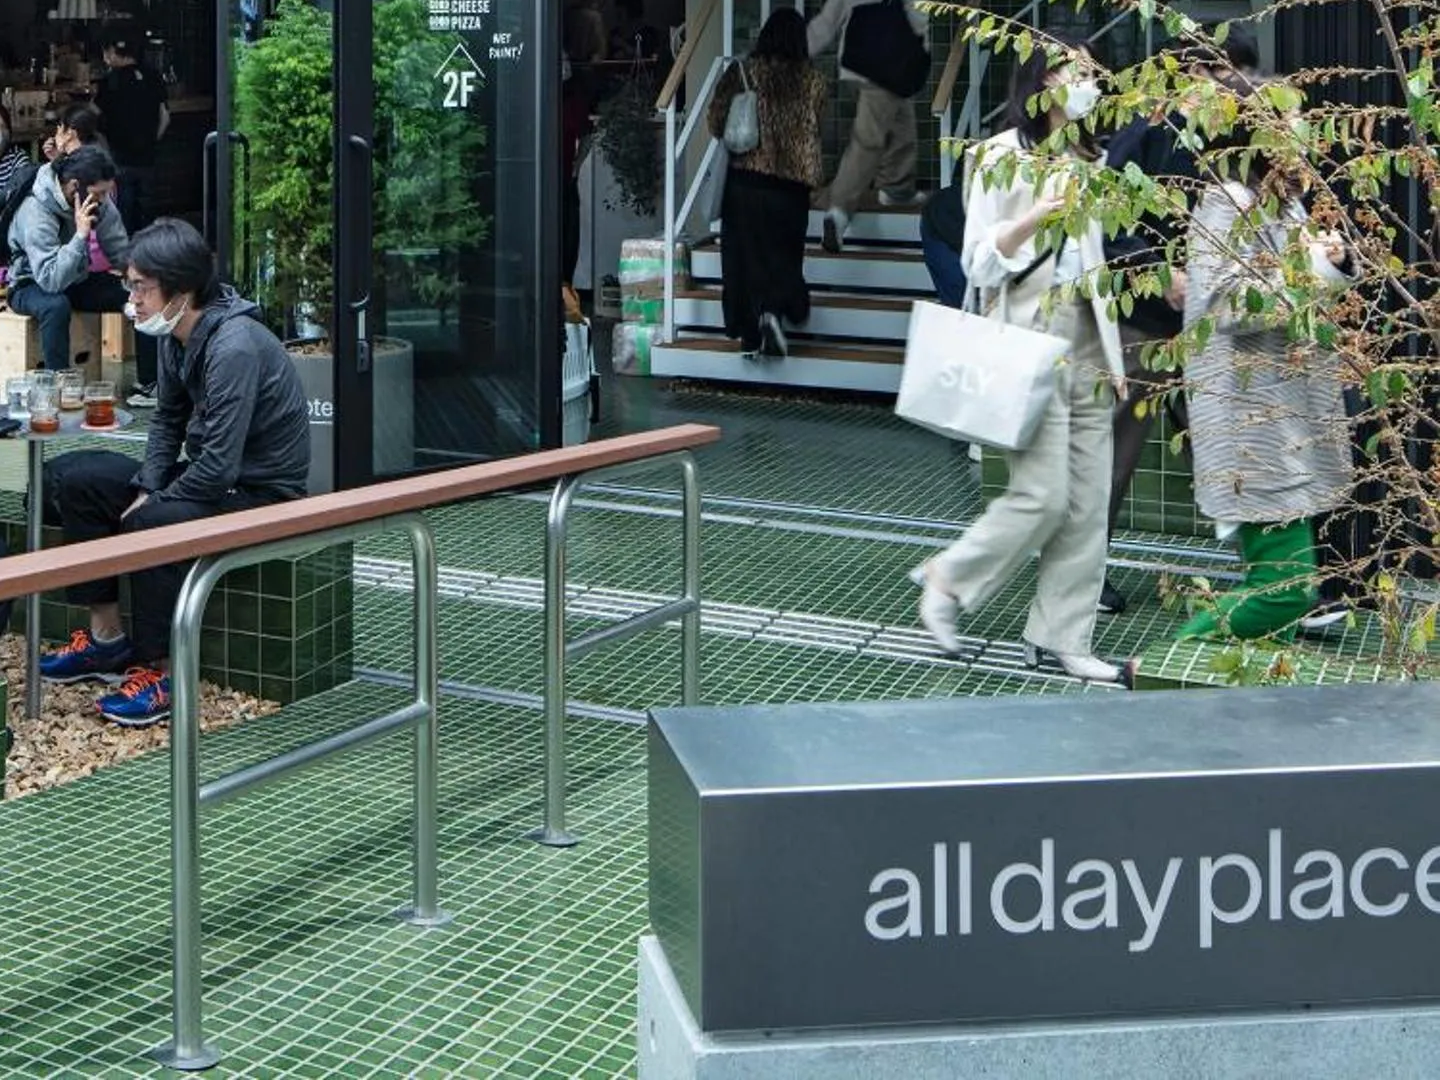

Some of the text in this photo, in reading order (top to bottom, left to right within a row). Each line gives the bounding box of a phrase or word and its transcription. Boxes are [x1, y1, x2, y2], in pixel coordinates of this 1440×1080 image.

[451, 0, 490, 13] CHEESE
[451, 15, 481, 30] PIZZA
[443, 71, 477, 108] 2F
[939, 358, 997, 396] SLY
[863, 841, 971, 942] all
[989, 837, 1183, 952] day
